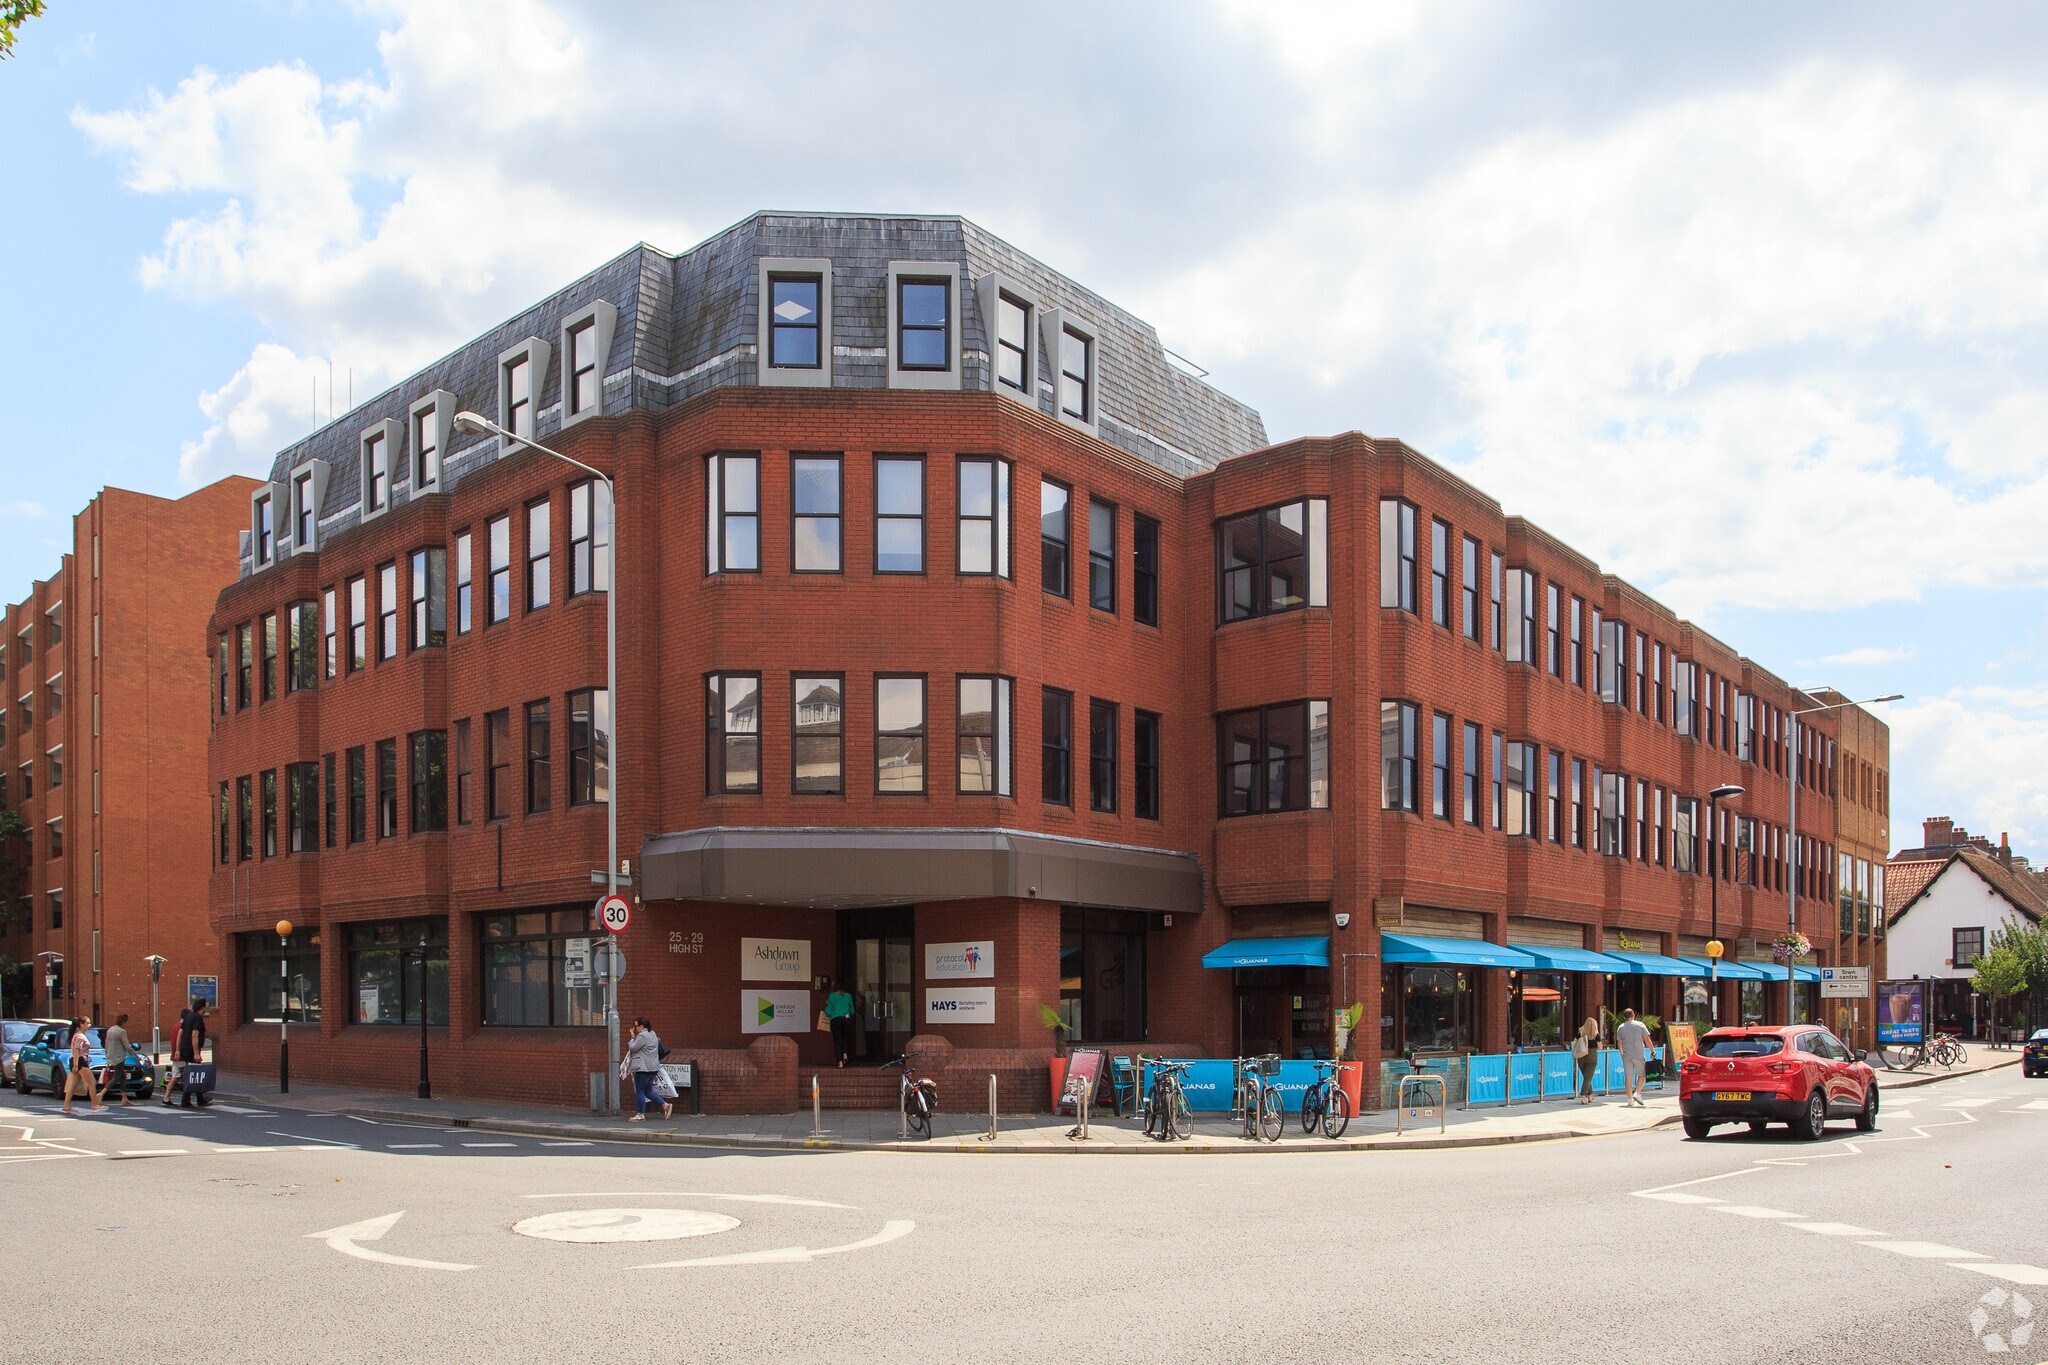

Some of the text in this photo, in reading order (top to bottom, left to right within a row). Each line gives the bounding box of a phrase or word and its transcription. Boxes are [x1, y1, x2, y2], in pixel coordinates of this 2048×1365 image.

[606, 907, 626, 923] 30
[669, 931, 682, 942] 25
[691, 932, 703, 943] 29
[669, 944, 703, 954] HIGH ST
[754, 945, 799, 960] Ashdown
[936, 953, 964, 964] protocol
[775, 960, 800, 974] Group
[936, 963, 967, 971] education
[931, 1000, 957, 1011] HAYS
[677, 1065, 690, 1073] HALL
[189, 1072, 206, 1084] GAP
[668, 1073, 679, 1081] OAD
[1716, 1092, 1750, 1100] GY67 TWC
